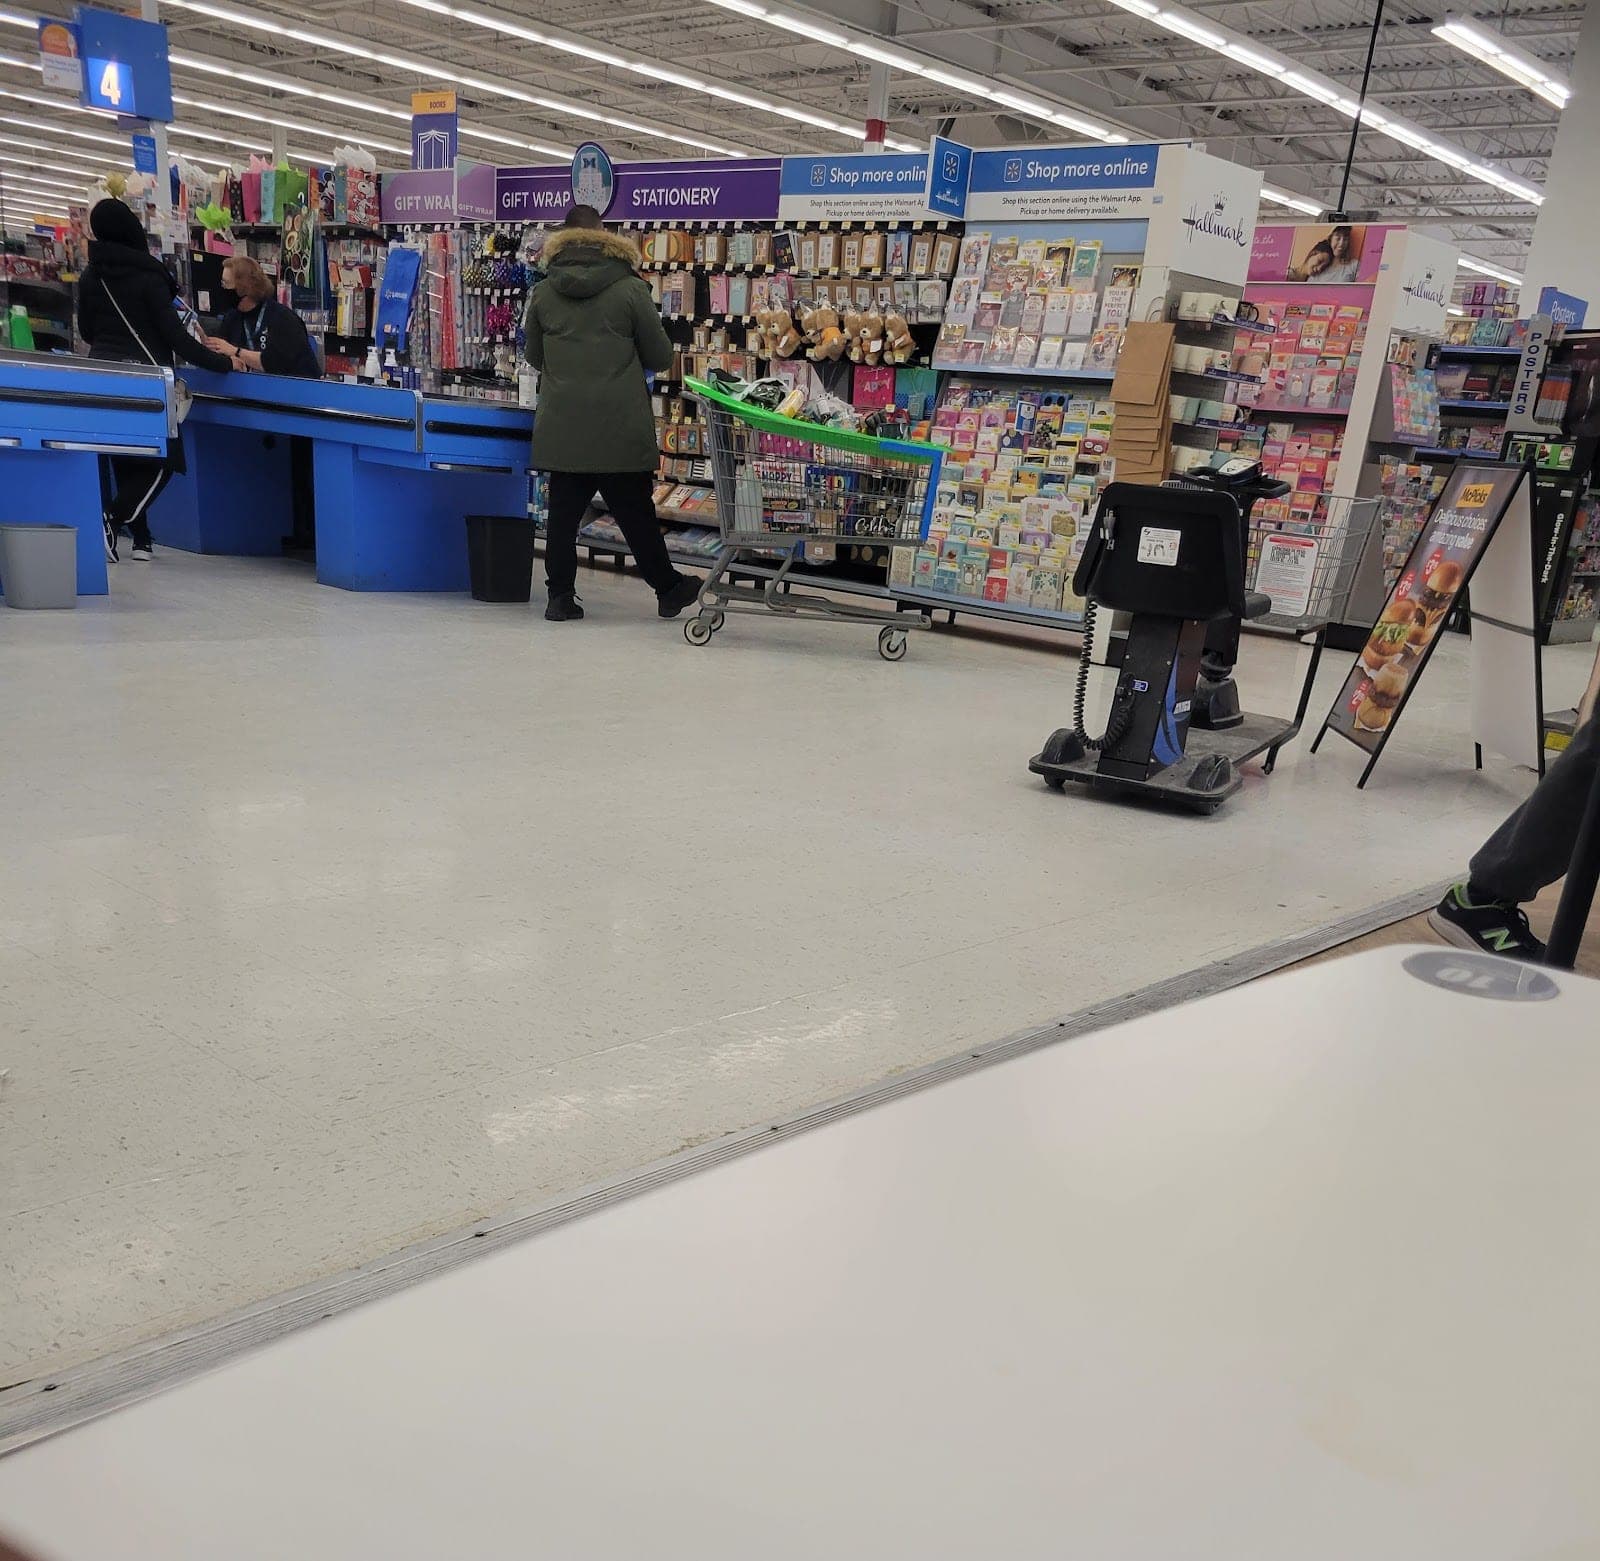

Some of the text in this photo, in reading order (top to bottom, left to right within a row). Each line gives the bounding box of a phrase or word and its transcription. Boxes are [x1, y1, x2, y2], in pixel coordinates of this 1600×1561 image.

[100, 62, 121, 106] 4
[830, 165, 927, 187] Shop more onlin
[1026, 158, 1149, 182] Shop more online
[394, 195, 421, 211] GIFT
[502, 191, 571, 208] GIFT WRAP
[632, 187, 721, 206] STATIONERY
[810, 199, 823, 207] Shop
[823, 199, 833, 207] this
[869, 199, 883, 208] using
[894, 198, 917, 206] Walmart
[1002, 194, 1143, 206] Shop this section online using the Walmart App.
[458, 203, 474, 212] GIFT
[825, 209, 843, 218] Pickup
[865, 209, 886, 218] delivery
[1020, 206, 1041, 216] Pickup
[1049, 206, 1064, 214] home
[1066, 206, 1089, 216] delivery
[1090, 205, 1120, 215] available.
[1182, 202, 1247, 248] Hallmark
[1403, 276, 1446, 308] Hallmark
[1107, 309, 1122, 318] YOU
[1551, 300, 1575, 324] Posters
[1513, 332, 1542, 415] POSTERS
[1462, 486, 1489, 504] McPicks
[1434, 508, 1462, 528] Delicious
[1540, 512, 1565, 584] Glow-In-The-Dark
[1479, 926, 1522, 952] N
